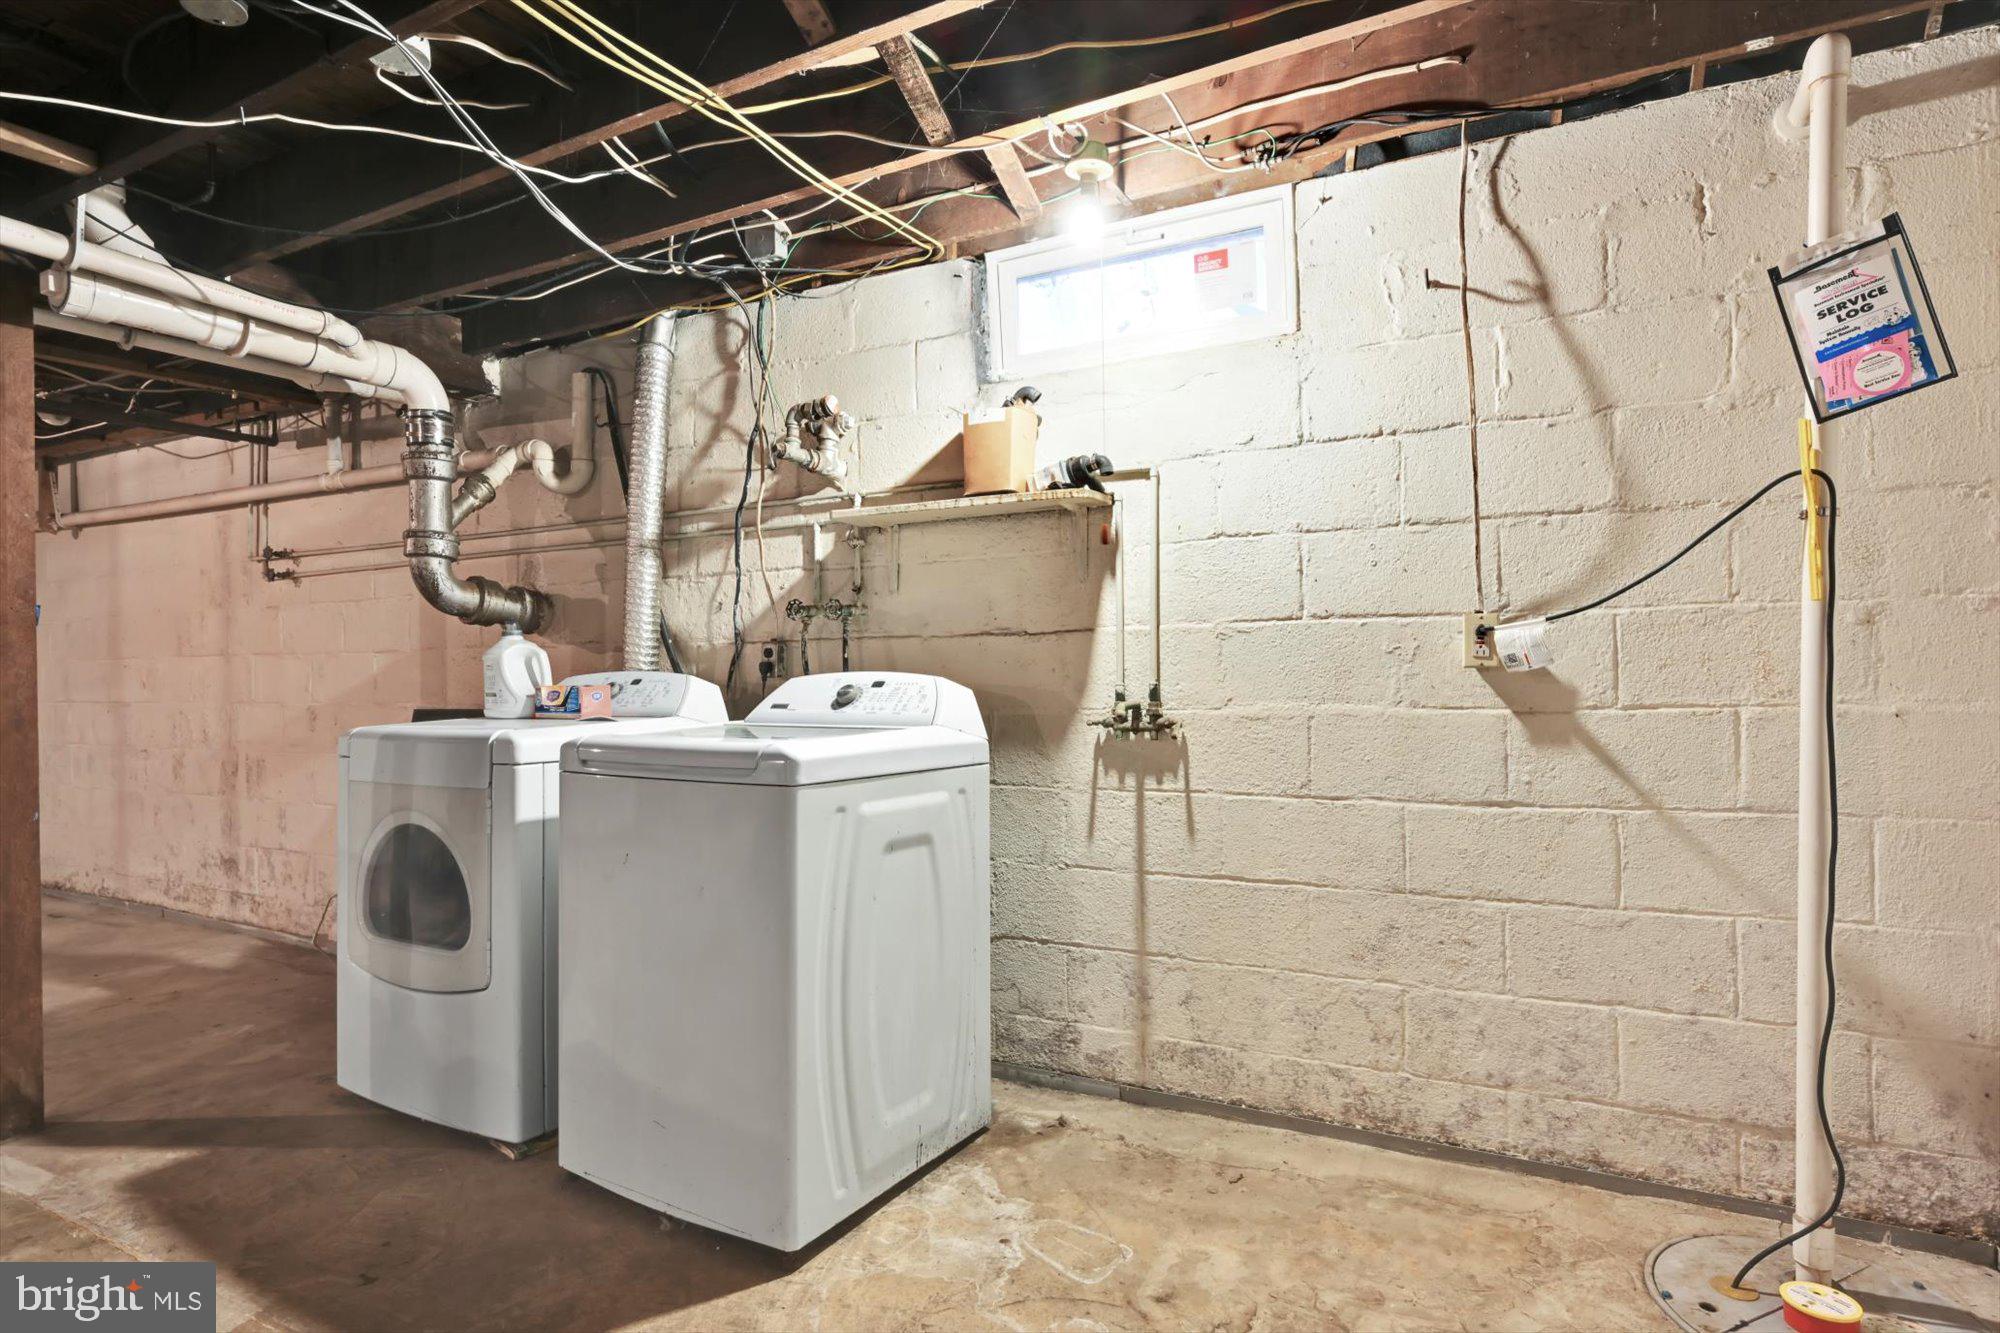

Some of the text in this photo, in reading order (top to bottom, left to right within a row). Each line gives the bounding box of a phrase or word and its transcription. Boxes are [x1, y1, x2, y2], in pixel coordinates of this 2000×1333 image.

[1814, 269, 1858, 294] Basement
[1817, 284, 1889, 320] SERVICE
[1836, 302, 1875, 324] LOG
